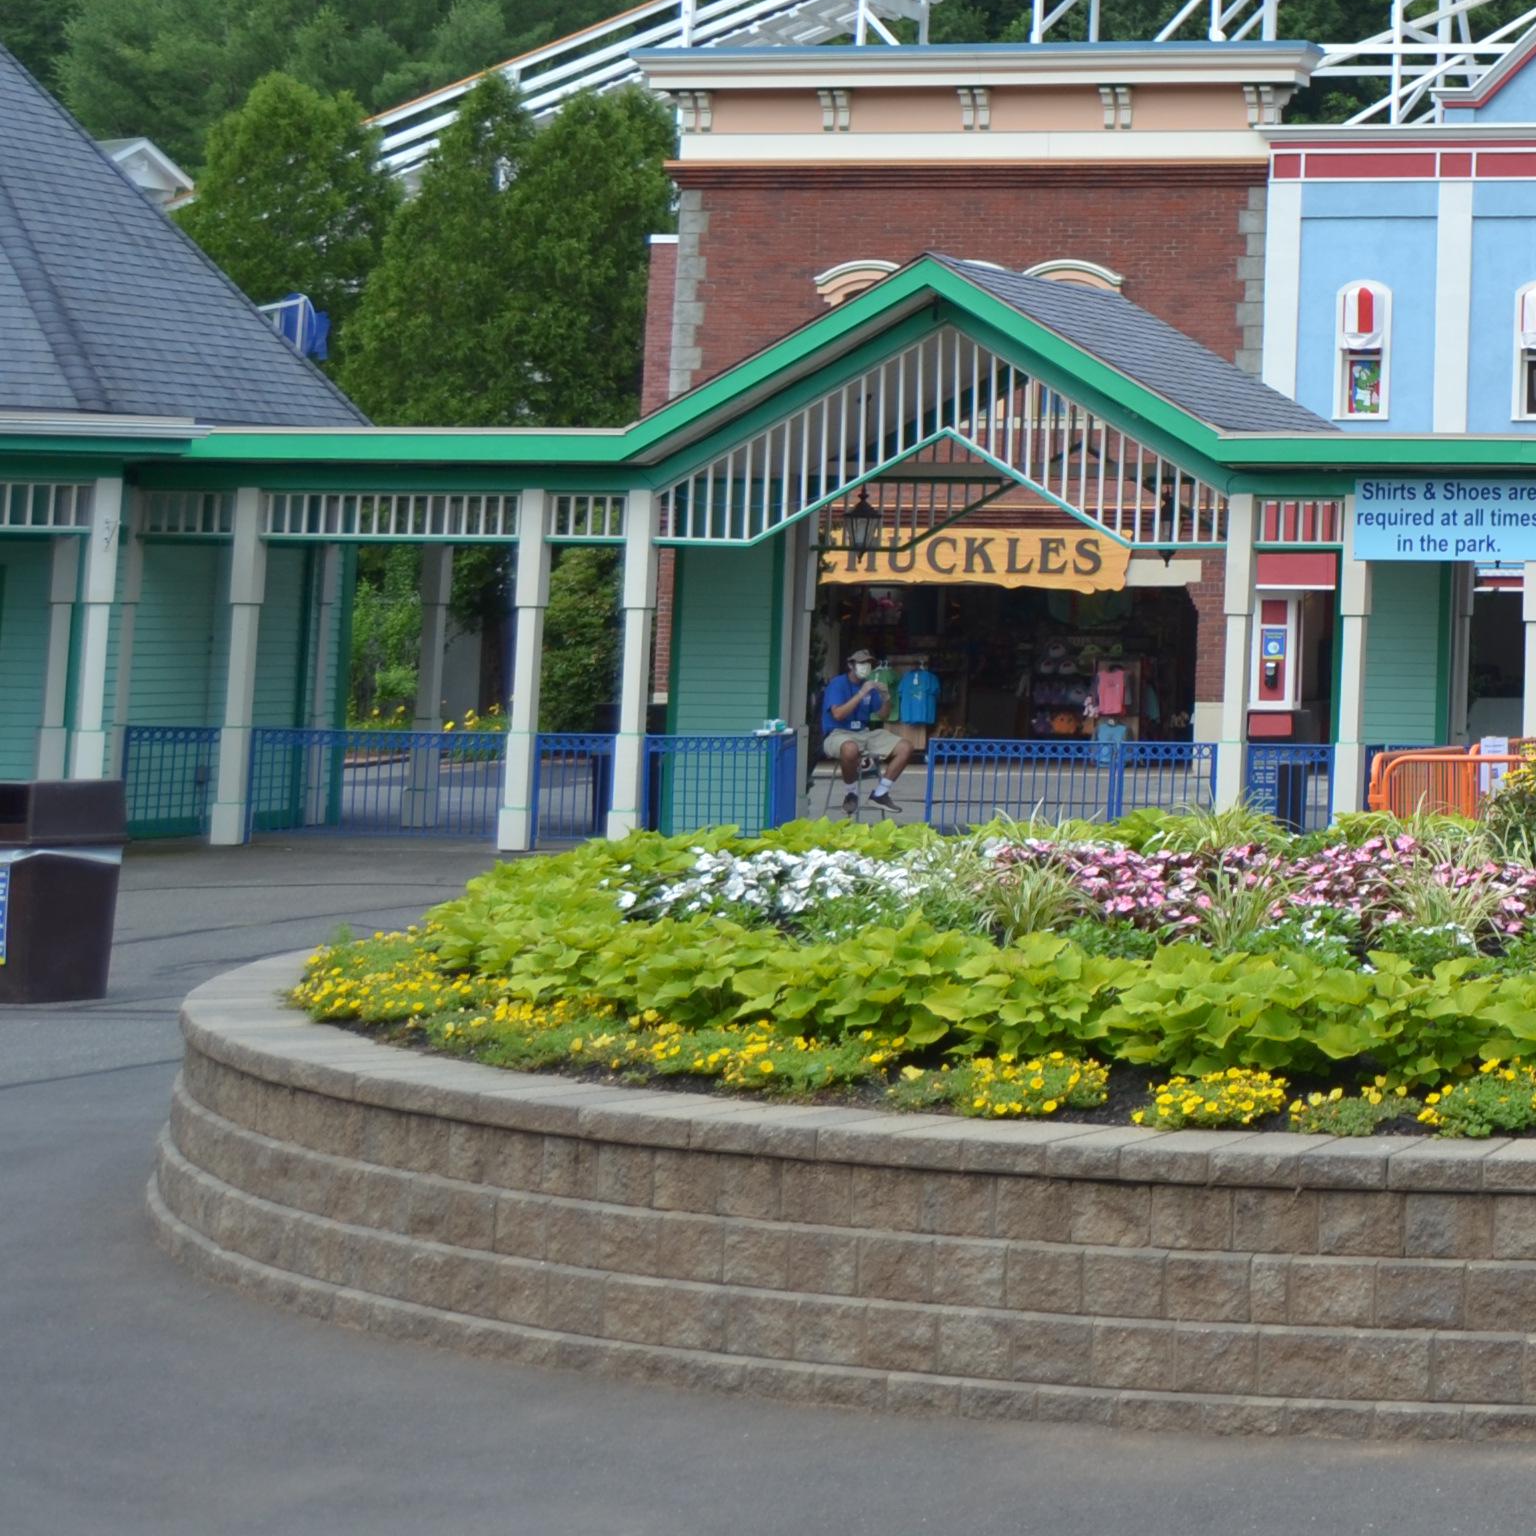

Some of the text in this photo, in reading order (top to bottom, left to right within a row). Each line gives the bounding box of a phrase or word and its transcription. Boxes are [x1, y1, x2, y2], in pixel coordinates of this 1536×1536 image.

[1362, 481, 1417, 501] Shirts
[1423, 482, 1436, 501] &
[1442, 481, 1502, 501] Shoes
[1356, 508, 1434, 530] required
[1440, 510, 1458, 526] at
[1463, 508, 1484, 526] all
[1397, 534, 1501, 556] in the park.
